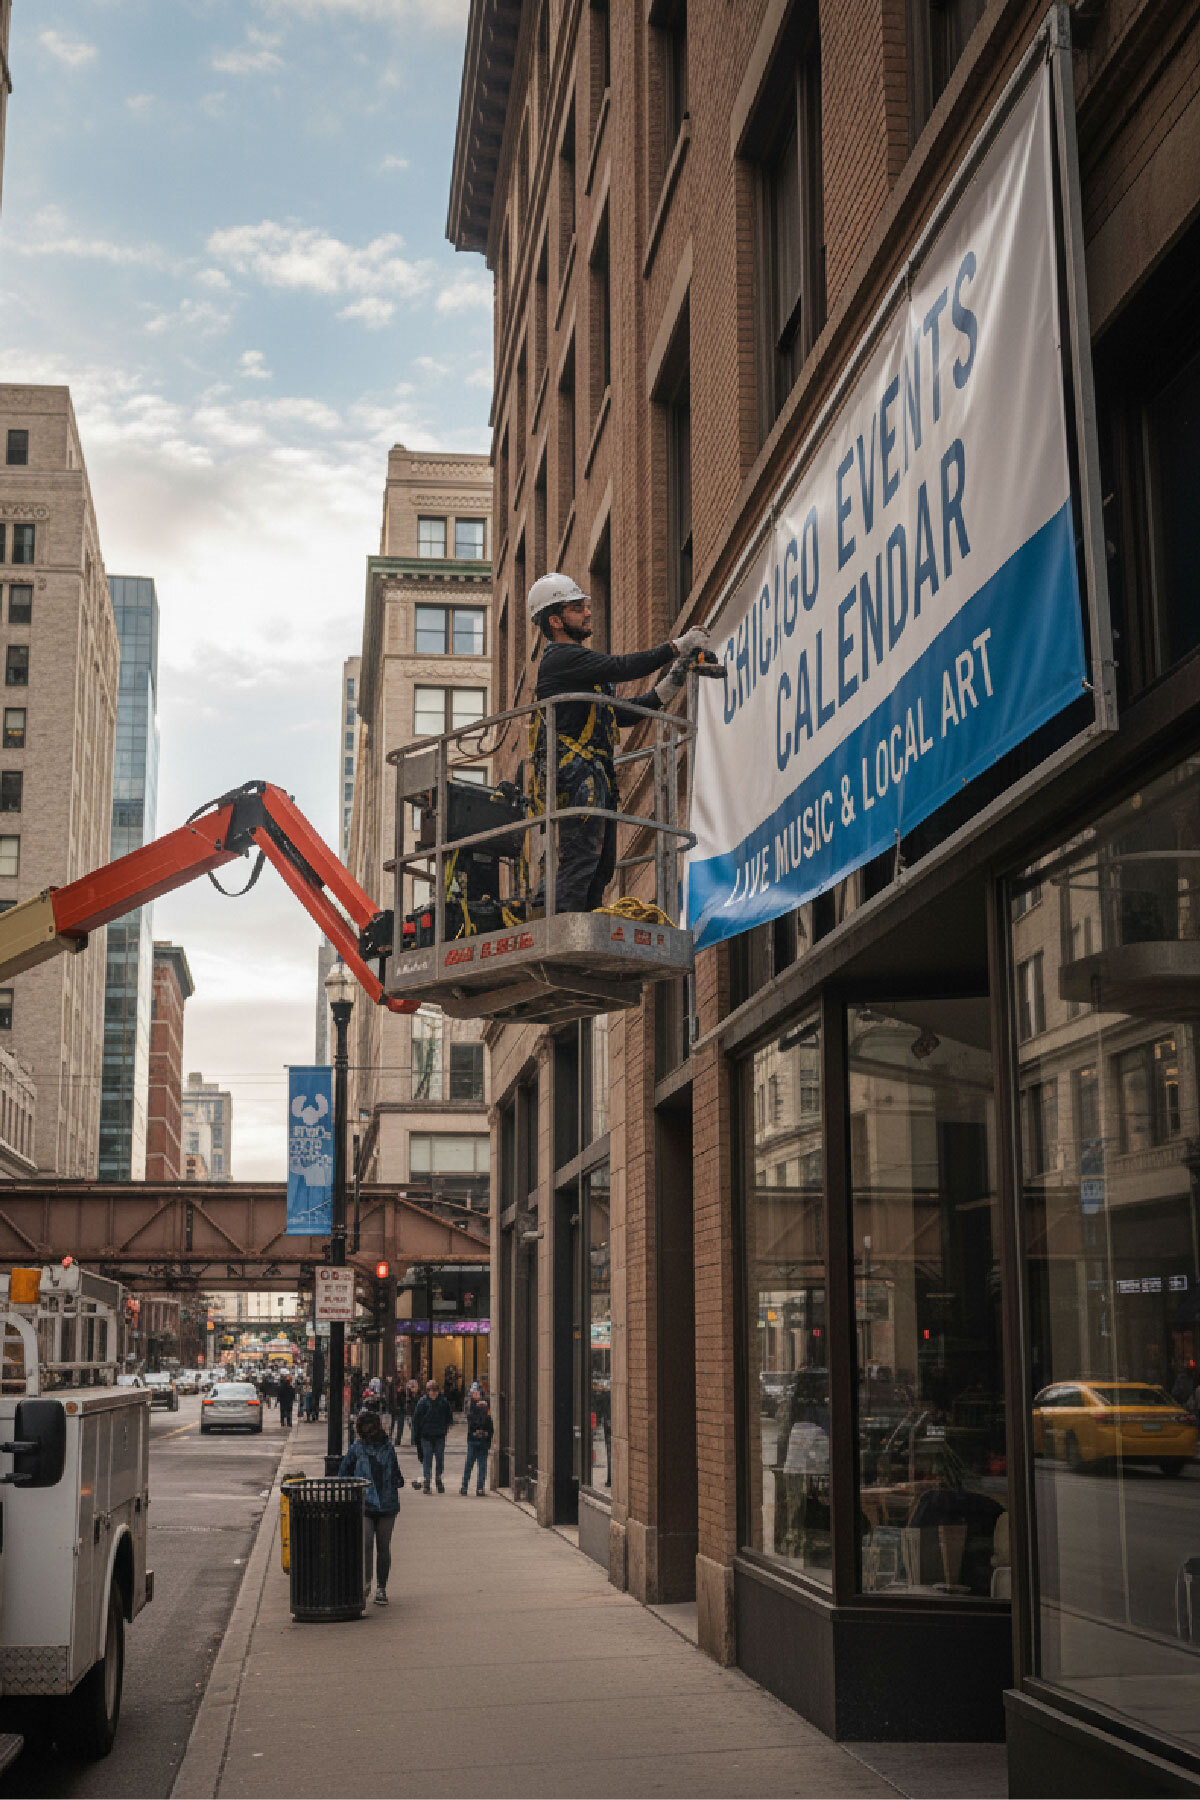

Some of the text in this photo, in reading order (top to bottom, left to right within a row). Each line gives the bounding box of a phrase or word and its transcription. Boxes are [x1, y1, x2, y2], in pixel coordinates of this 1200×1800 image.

[836, 251, 978, 572] EVENTS
[776, 438, 971, 771] CALENDAR
[724, 628, 995, 907] LIVE MUSIC & LOCAL ART
